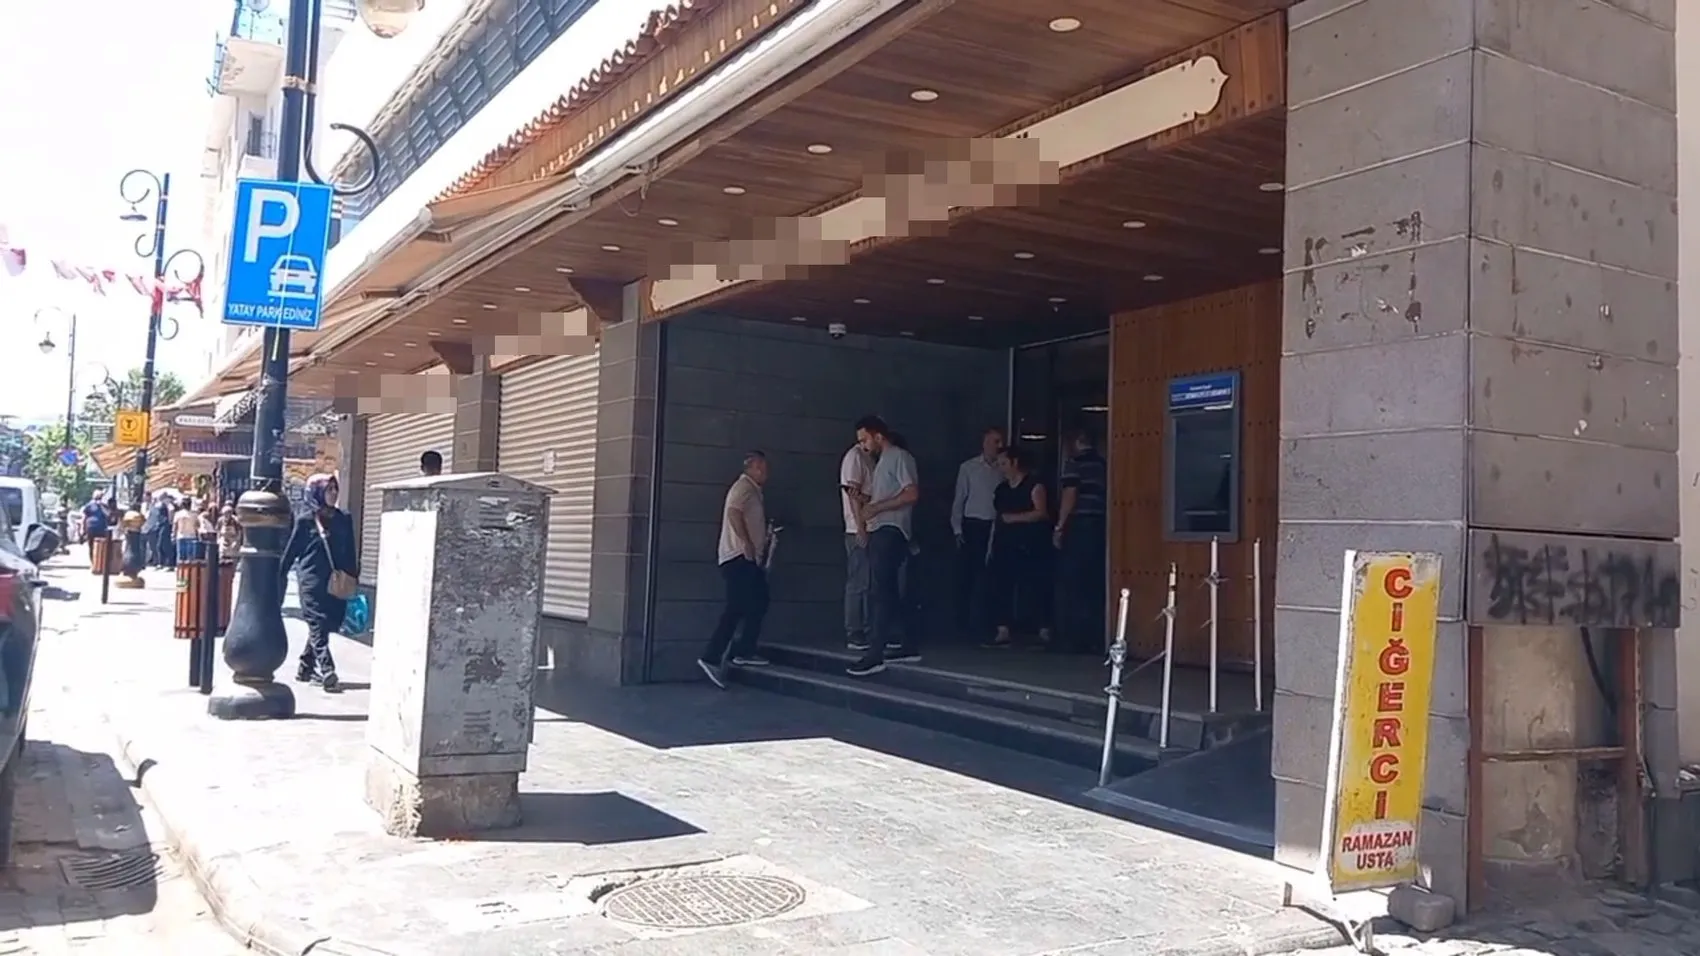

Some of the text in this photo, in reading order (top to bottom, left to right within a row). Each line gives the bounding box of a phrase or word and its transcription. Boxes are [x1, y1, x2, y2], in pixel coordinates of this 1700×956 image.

[244, 188, 300, 263] P
[228, 303, 256, 317] YATAY
[256, 305, 281, 319] PARK
[1342, 831, 1413, 853] RAMAZAN
[1356, 851, 1394, 870] USTA
